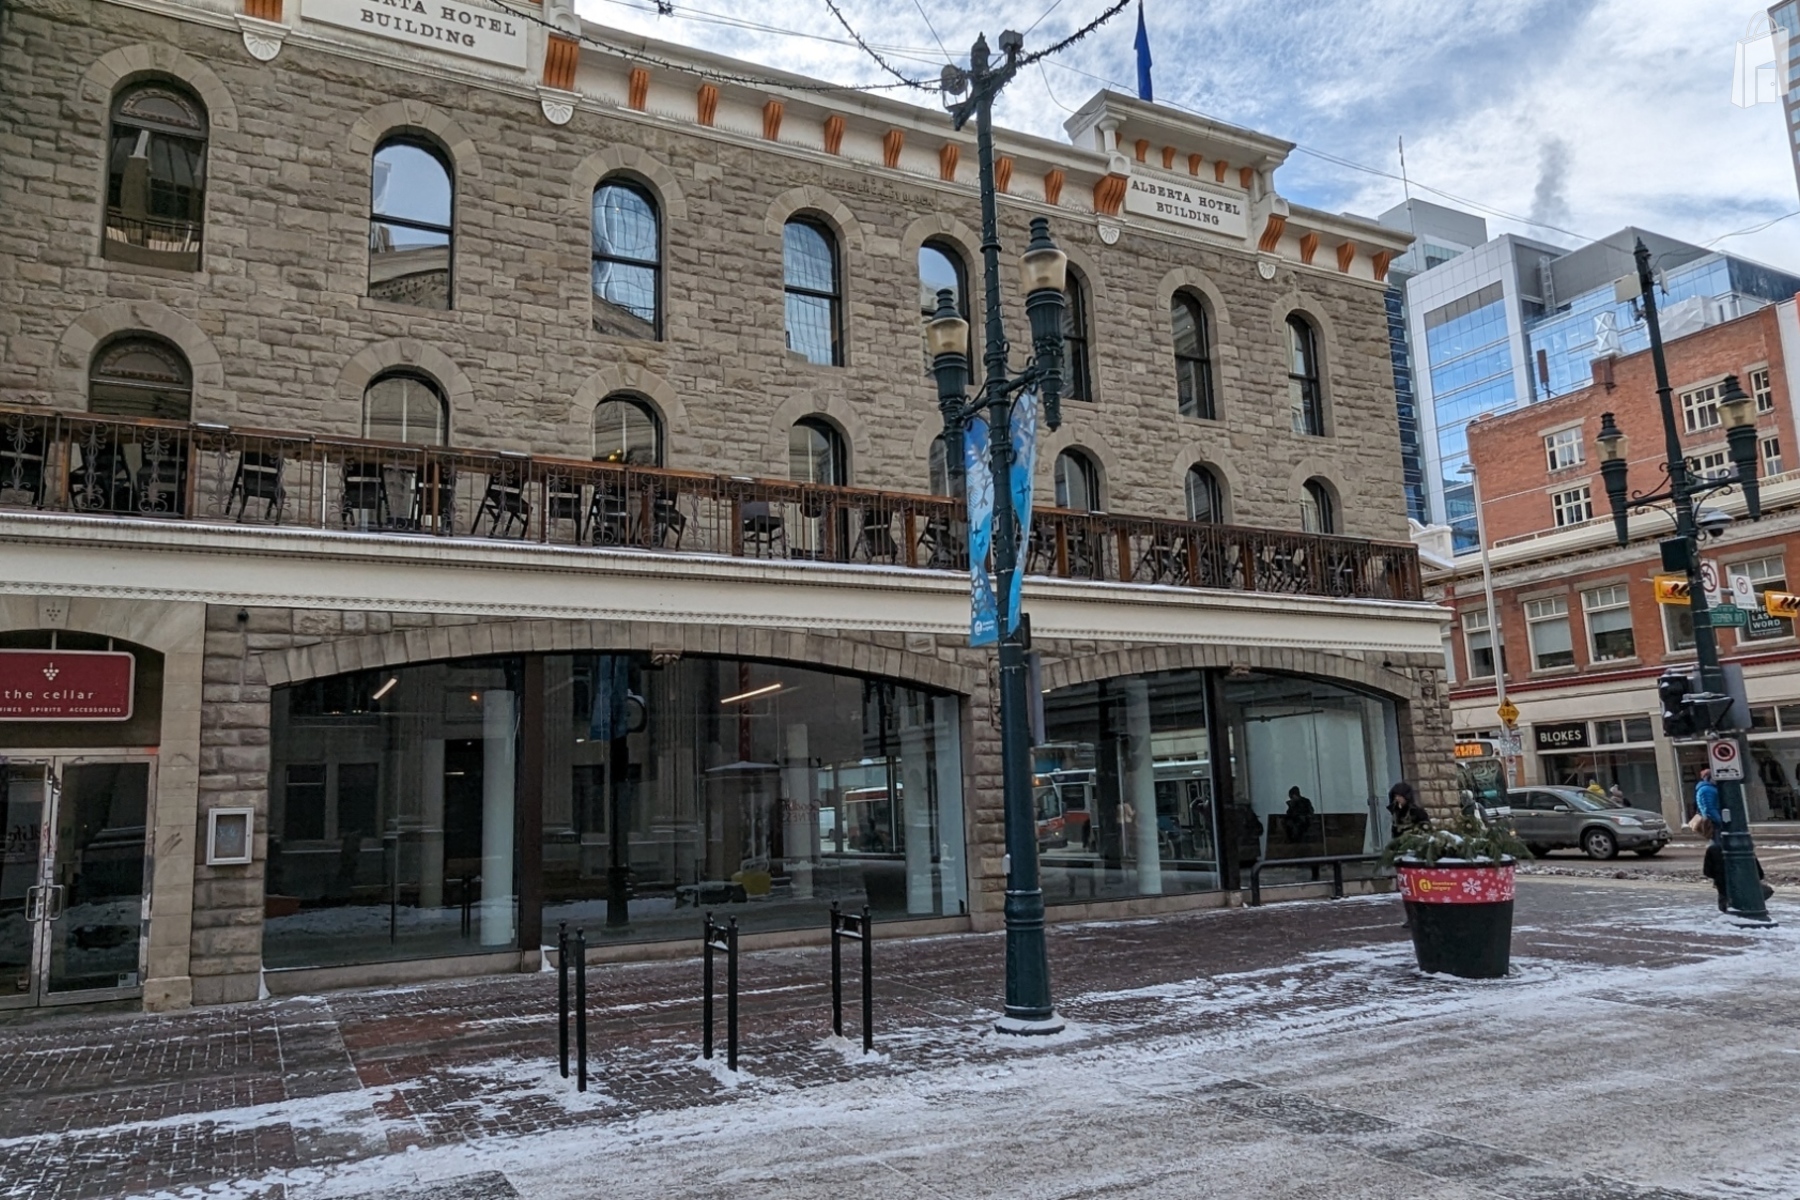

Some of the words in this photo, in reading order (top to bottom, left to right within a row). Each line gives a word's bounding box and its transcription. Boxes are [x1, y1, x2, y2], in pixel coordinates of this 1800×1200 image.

[360, 9, 475, 48] BUILDING
[441, 6, 516, 37] HOTEL
[1131, 180, 1191, 204] ALBERTA
[1199, 197, 1241, 216] HOTEL
[1156, 202, 1220, 226] BUILDING
[1752, 618, 1781, 629] WORD
[5, 689, 33, 699] the
[43, 689, 95, 700] cellar
[1540, 729, 1582, 743] BLOKES
